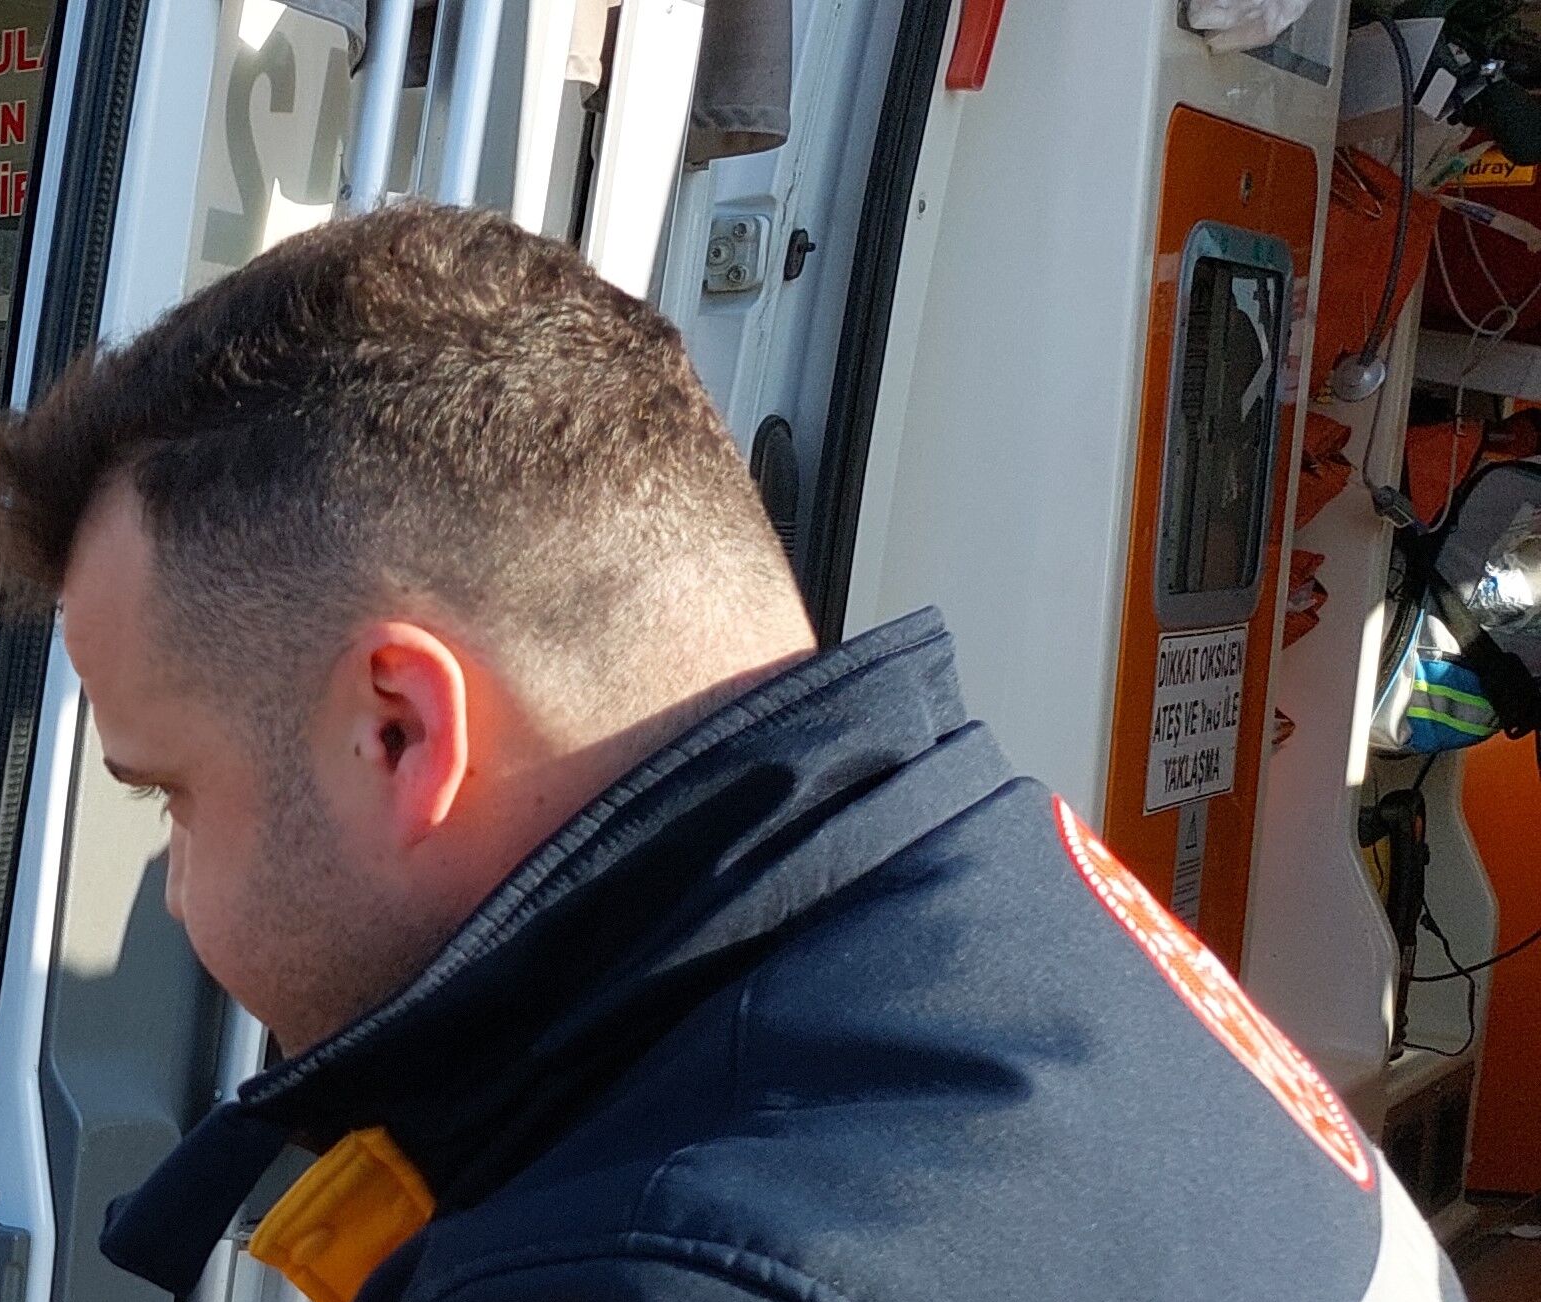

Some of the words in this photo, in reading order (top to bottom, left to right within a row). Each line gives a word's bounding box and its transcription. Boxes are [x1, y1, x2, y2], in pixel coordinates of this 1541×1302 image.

[1463, 158, 1516, 179] dray
[1157, 640, 1200, 688] DİKKAT
[1199, 634, 1245, 682] OKSİJEN
[1152, 701, 1183, 748] ATEŞ
[1183, 700, 1199, 737] VE
[1221, 686, 1240, 729] İLE
[1163, 747, 1220, 793] YAKLAŞMA
